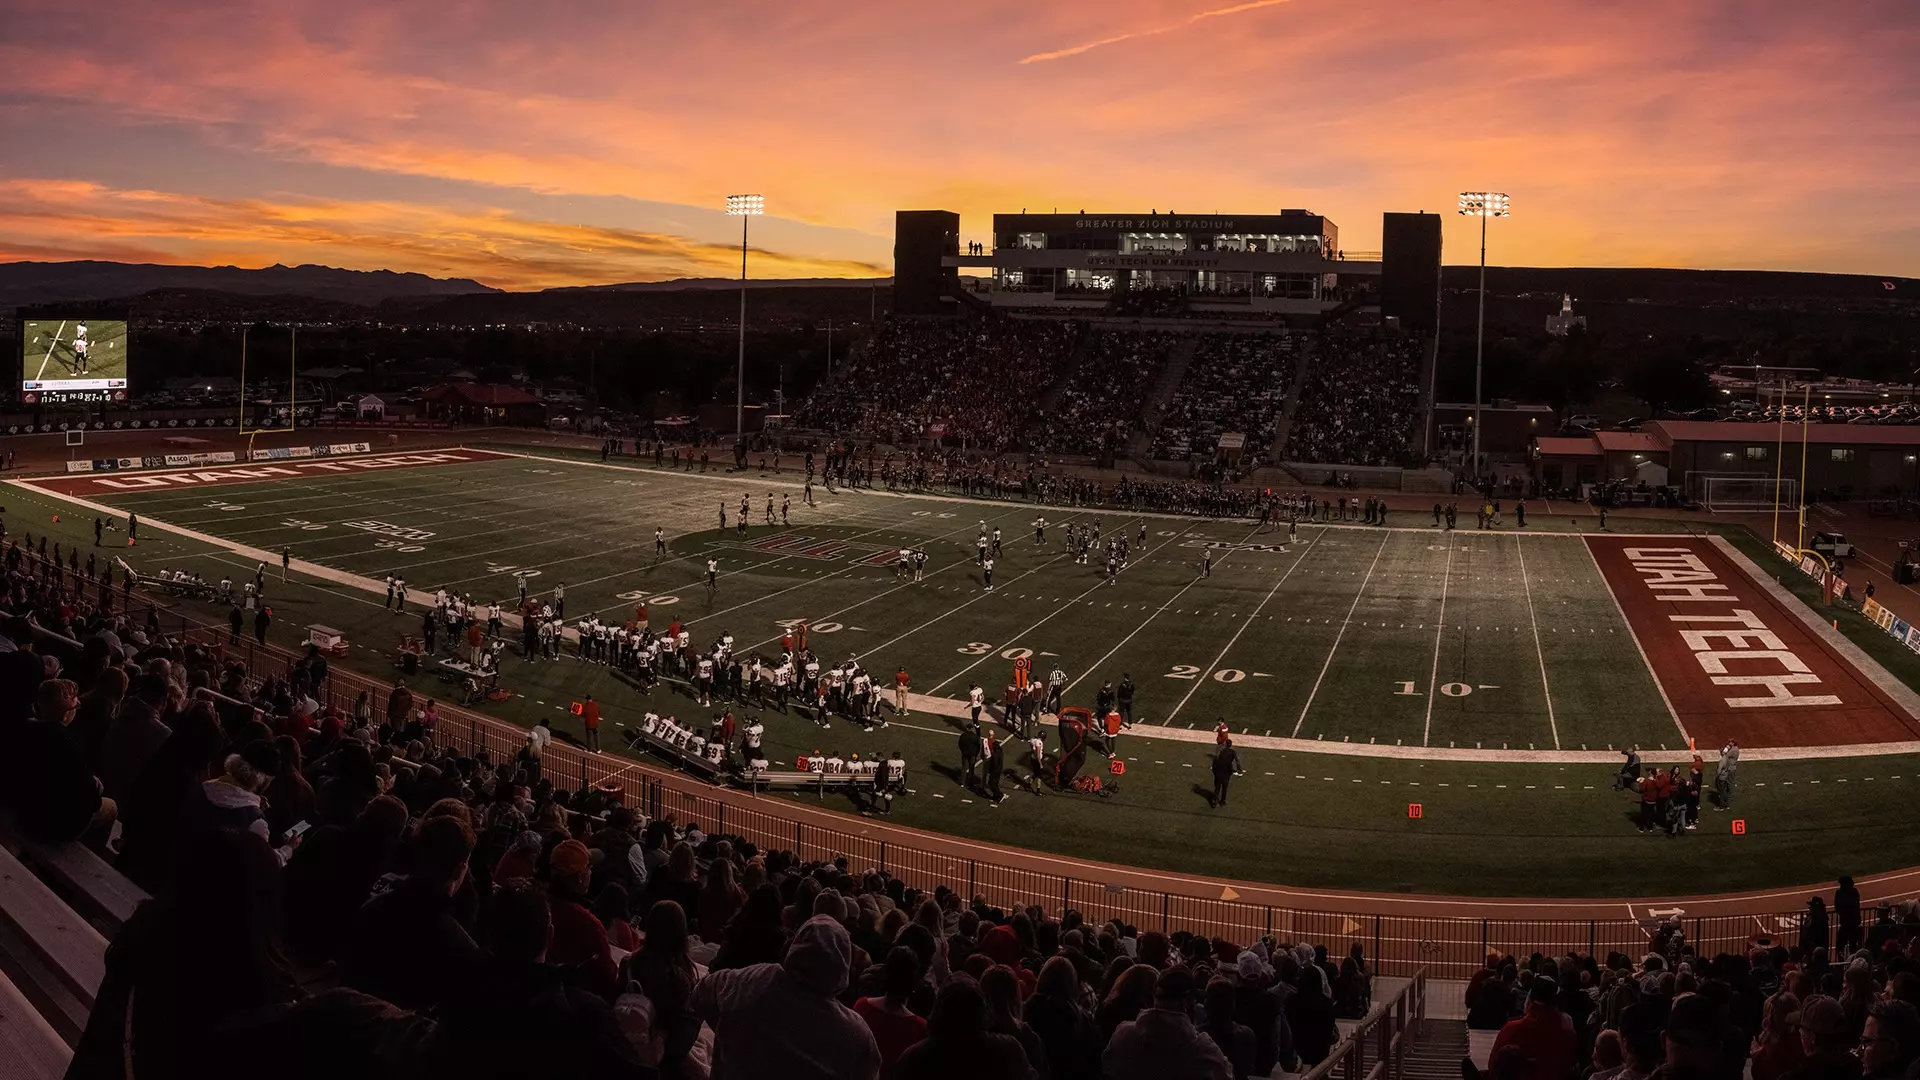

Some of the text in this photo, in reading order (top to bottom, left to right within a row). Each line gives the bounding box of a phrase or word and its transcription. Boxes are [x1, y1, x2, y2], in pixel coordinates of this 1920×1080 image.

[1076, 219, 1234, 229] GREATER ZION STADIUM
[1087, 258, 1219, 267] UTAH TECH UNIVERSITY
[92, 466, 303, 489] UTAH
[296, 453, 473, 472] TECH
[1623, 547, 1741, 602] UTAH
[615, 590, 680, 606] 50
[774, 617, 844, 634] 40
[956, 642, 1034, 660] 30
[1667, 608, 1844, 709] TECH
[1163, 664, 1247, 683] 20
[1393, 680, 1473, 698] 10
[810, 761, 823, 771] 20
[1112, 762, 1122, 773] 20
[1410, 806, 1421, 817] 10
[1735, 821, 1743, 832] G
